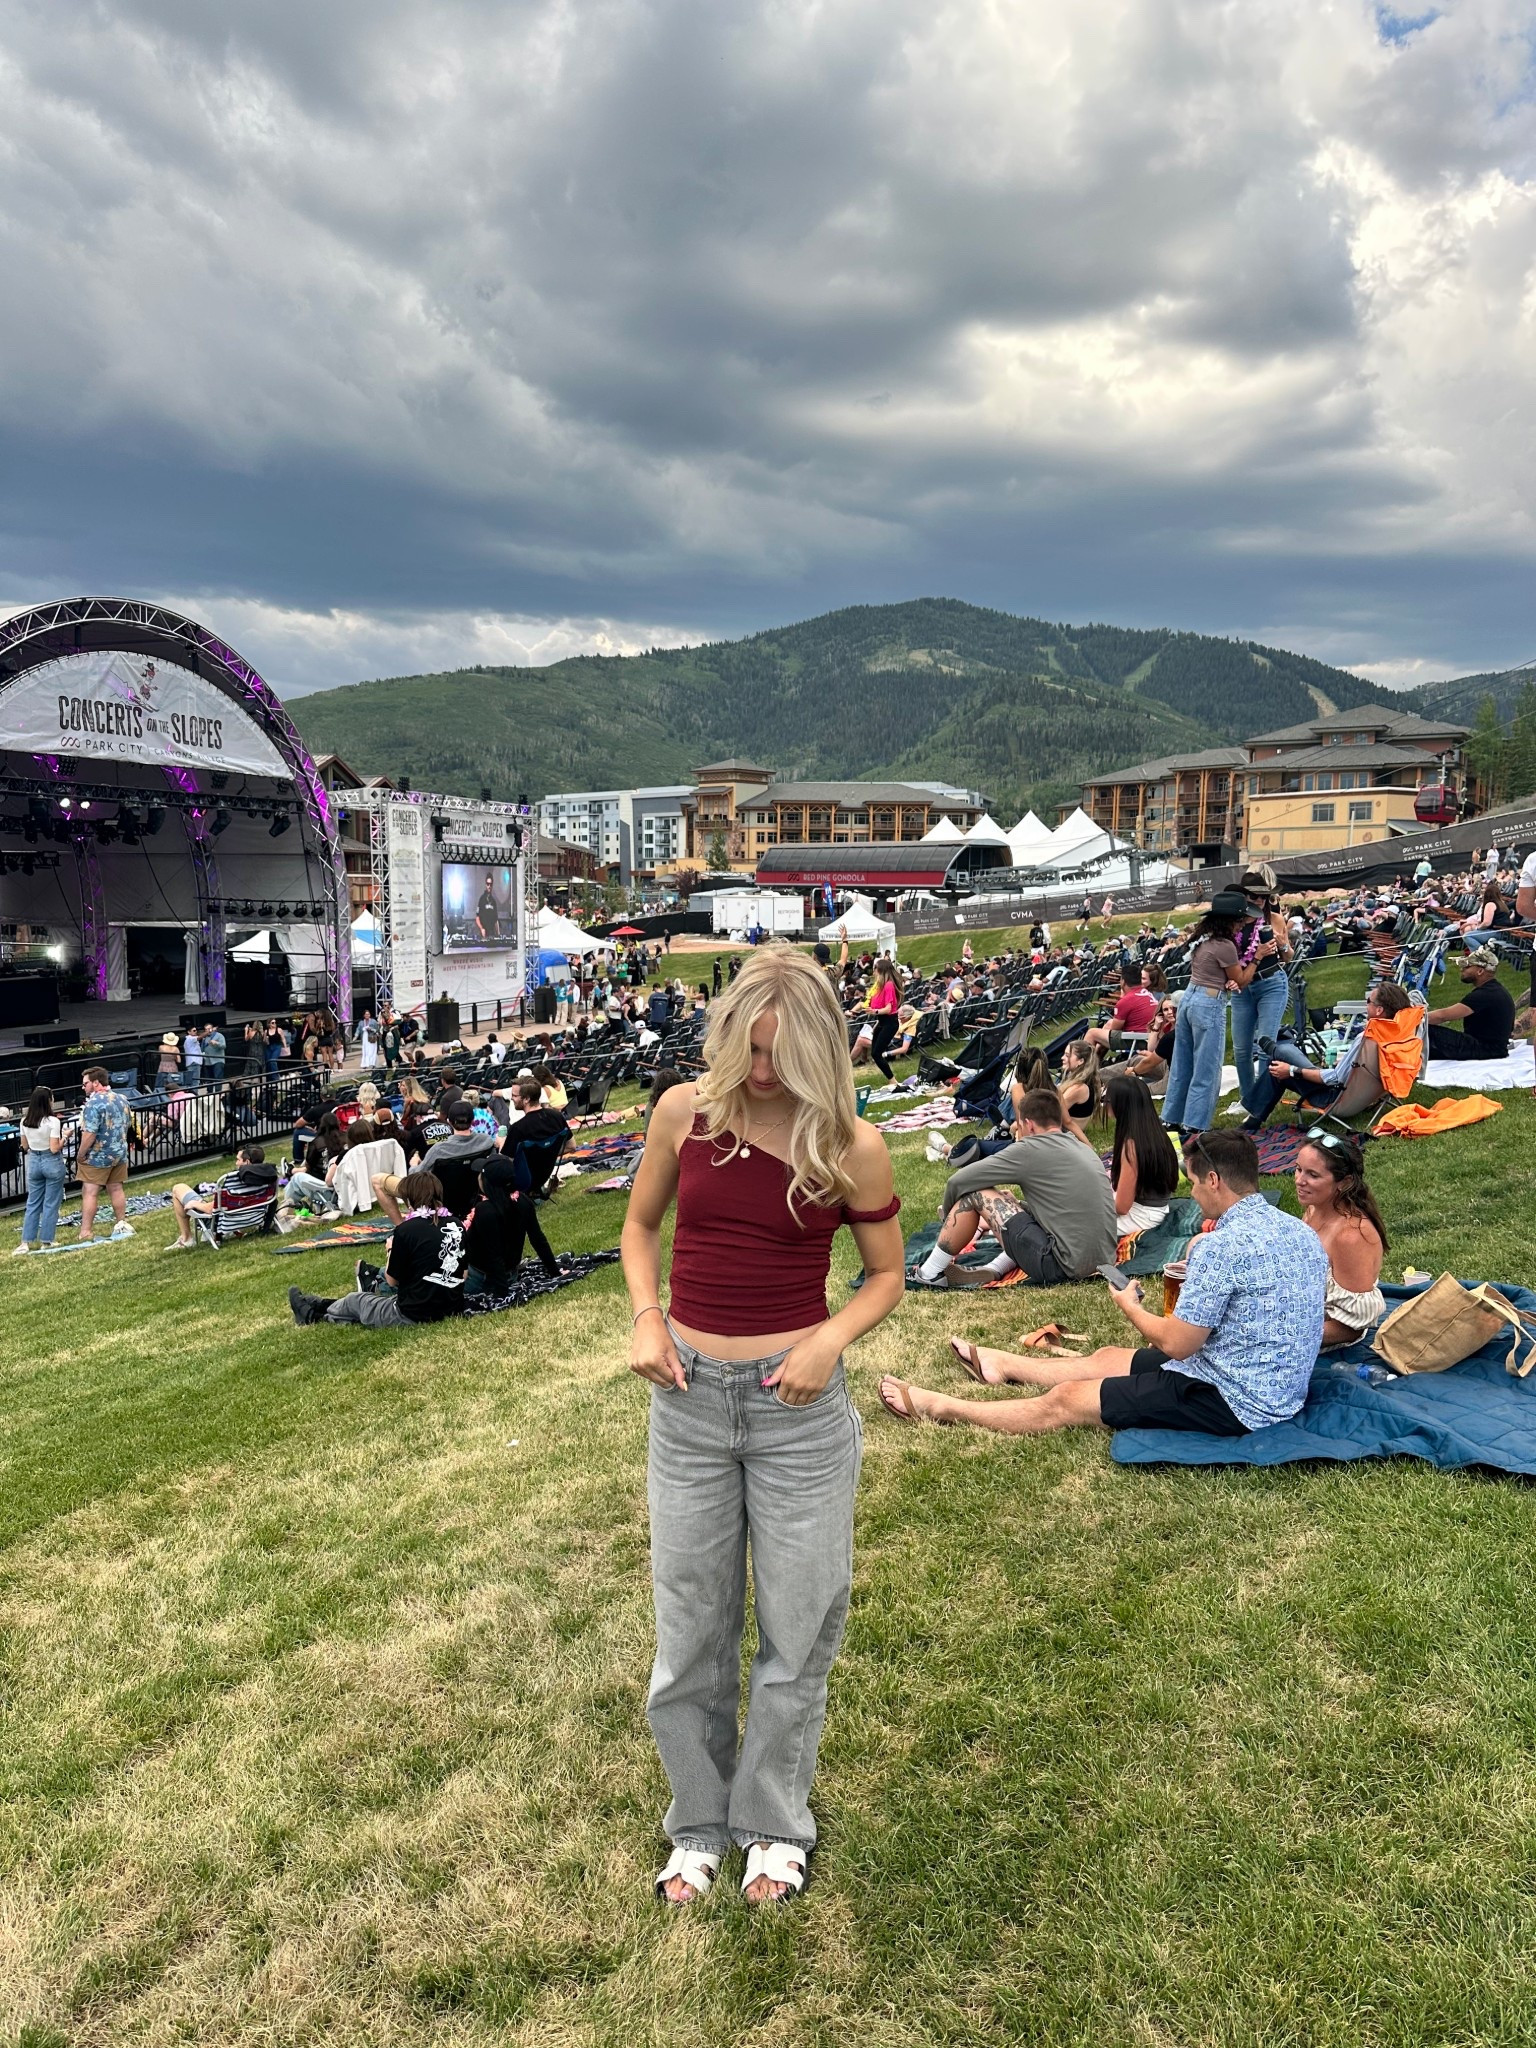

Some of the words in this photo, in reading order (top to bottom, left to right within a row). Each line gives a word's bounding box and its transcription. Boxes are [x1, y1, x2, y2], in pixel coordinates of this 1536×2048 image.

[58, 695, 143, 738] CONCERTS
[147, 717, 157, 732] ON
[159, 719, 170, 734] THE
[170, 712, 223, 750] SLOPES
[85, 738, 114, 752] PARK
[119, 742, 143, 755] CITY
[154, 748, 193, 760] CANYONS
[392, 809, 418, 823] CONCERTS
[399, 823, 418, 836] SLOPES
[481, 821, 503, 838] SLOPES
[1505, 823, 1524, 832] PARK
[1525, 820, 1536, 828] CIT
[1414, 843, 1433, 851] PARK
[1434, 839, 1451, 848] CITY
[1329, 860, 1346, 868] PARK
[1347, 856, 1363, 864] CITY
[803, 873, 816, 881] RED
[816, 873, 831, 881] PINE
[832, 873, 866, 882] GONDOLA
[1010, 910, 1034, 920] CVMA
